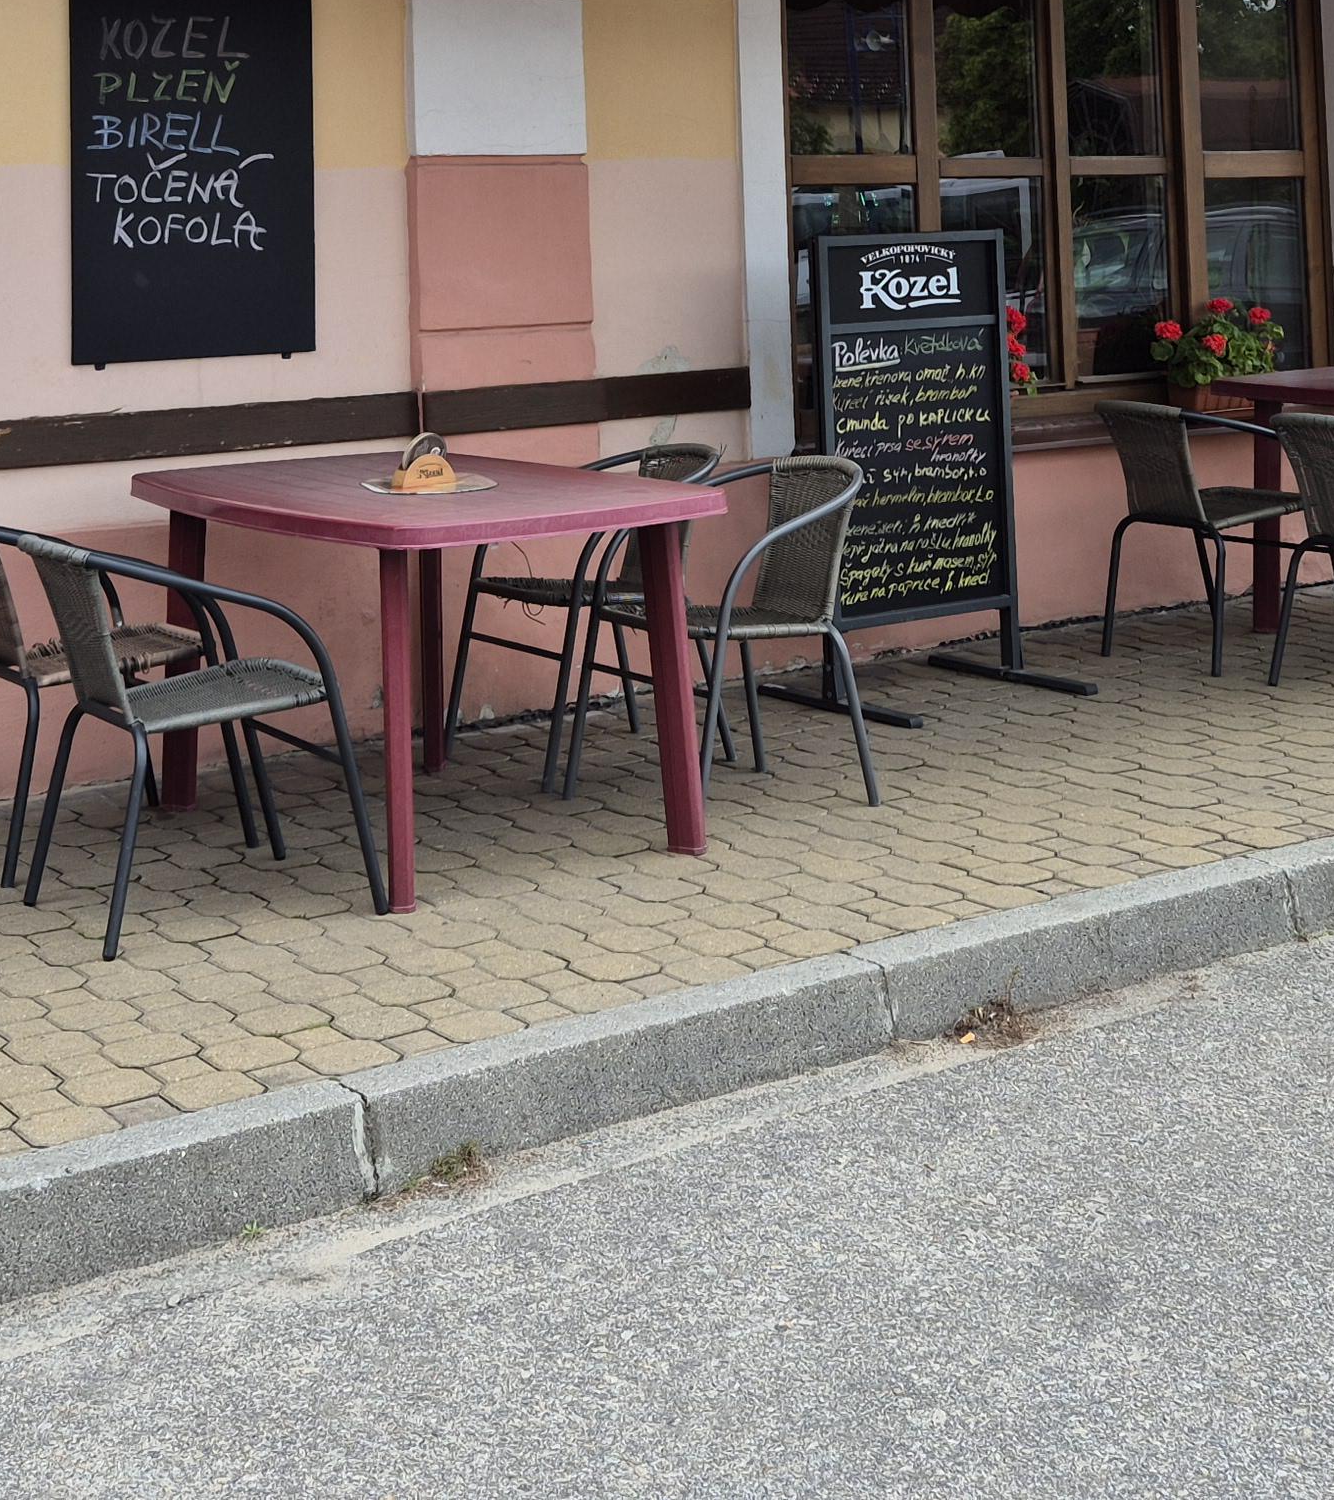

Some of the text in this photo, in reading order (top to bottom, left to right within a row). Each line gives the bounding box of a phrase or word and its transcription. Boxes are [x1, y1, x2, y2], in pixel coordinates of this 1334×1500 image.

[98, 13, 251, 61] KOZEL
[93, 60, 240, 106] PLZEŇ
[85, 112, 240, 156] BIRELL
[85, 151, 275, 209] TOČENÁ
[112, 206, 268, 253] KOFOLA
[859, 244, 956, 265] VELKOPOPOVICKÝ
[899, 253, 921, 265] 1874
[858, 265, 962, 311] Kozel
